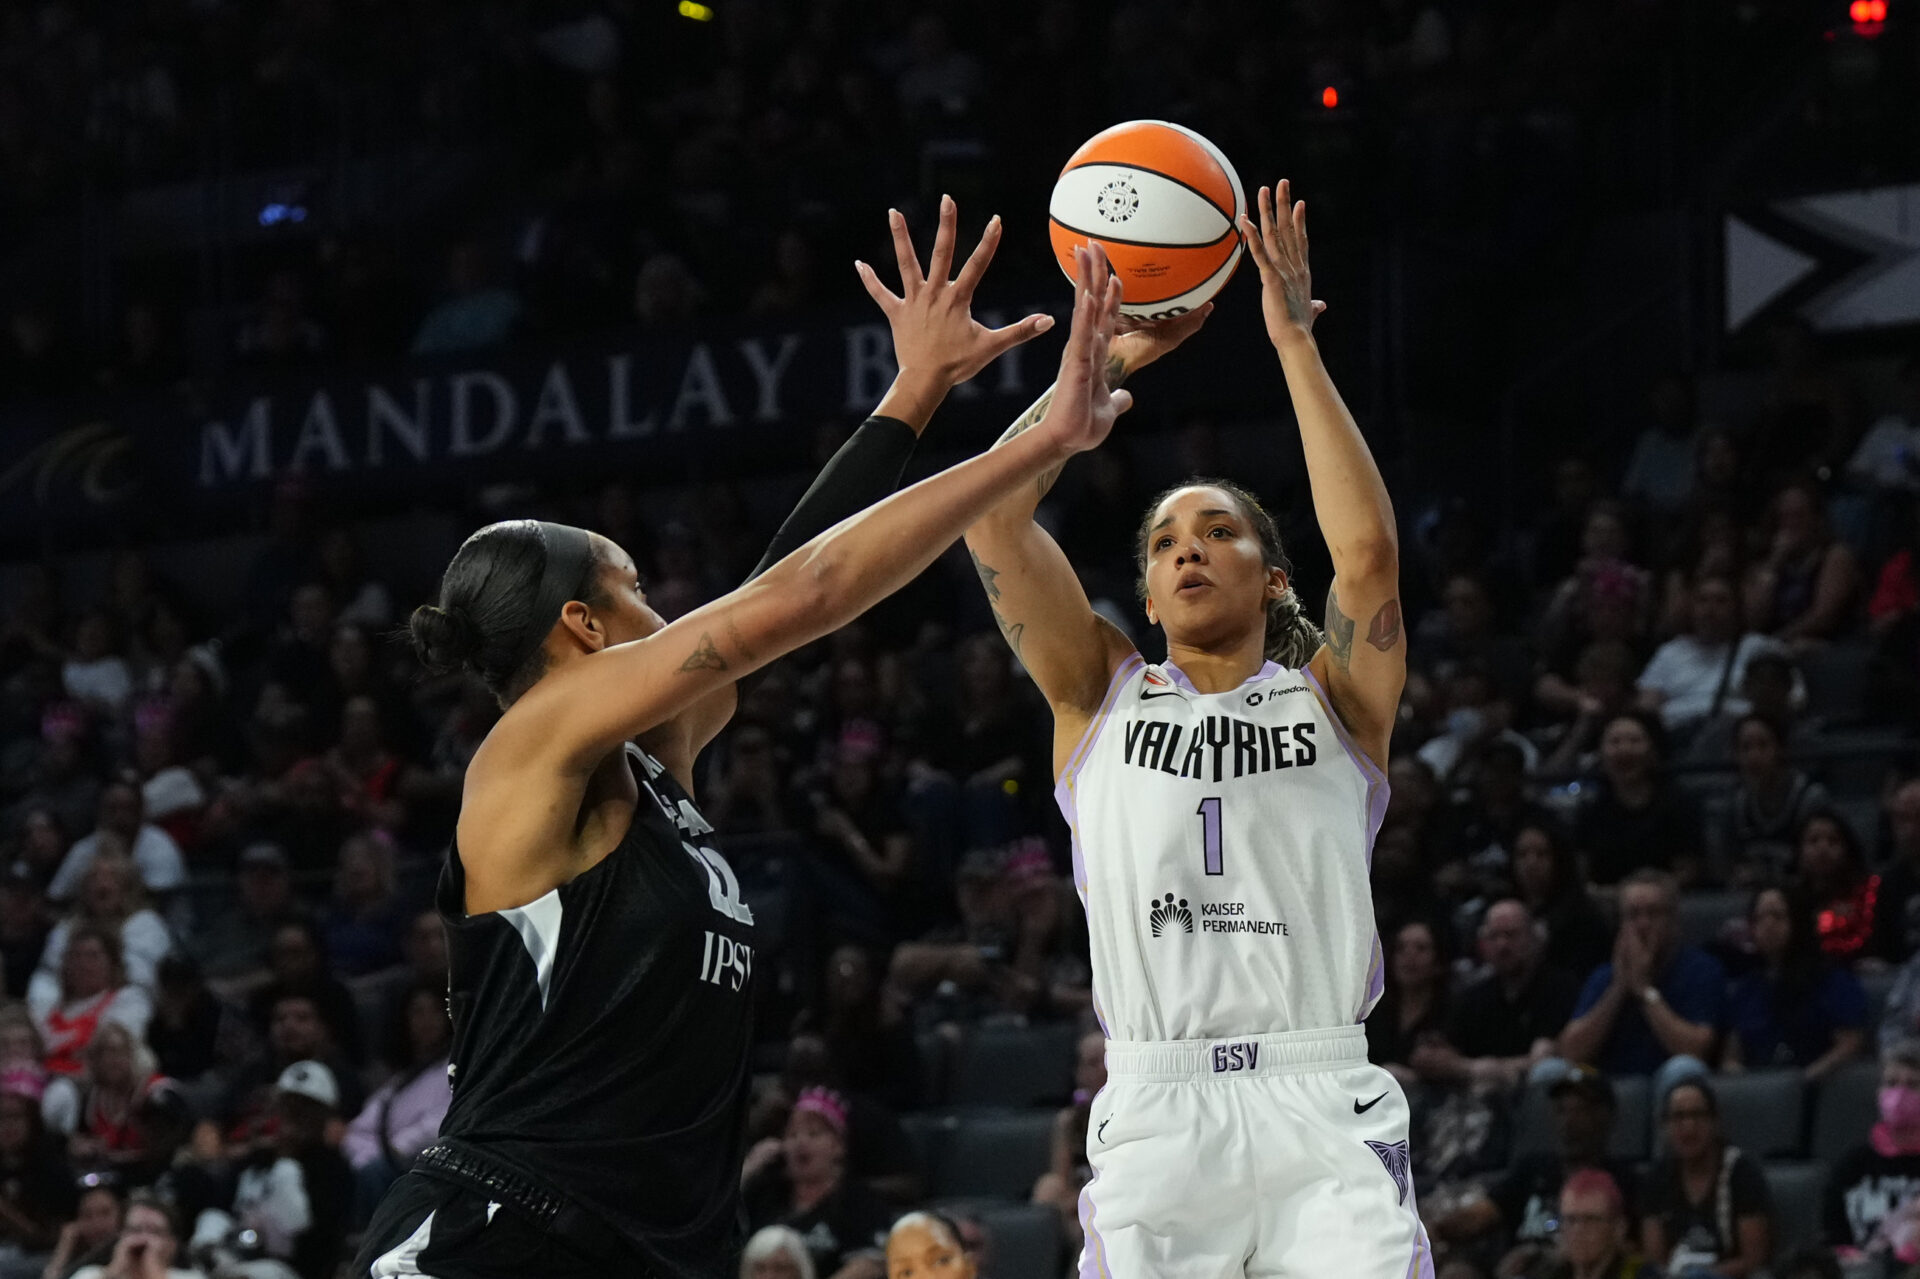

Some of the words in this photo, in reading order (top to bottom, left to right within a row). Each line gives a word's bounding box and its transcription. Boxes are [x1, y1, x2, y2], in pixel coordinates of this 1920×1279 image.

[199, 333, 802, 488] MANDALAY
[1268, 684, 1311, 701] freedom
[1125, 715, 1317, 783] VALKYRIES
[1196, 797, 1224, 876] 1
[1201, 903, 1245, 916] KAISER
[1203, 920, 1289, 936] PERMANENTE
[1212, 1042, 1258, 1073] GSV
